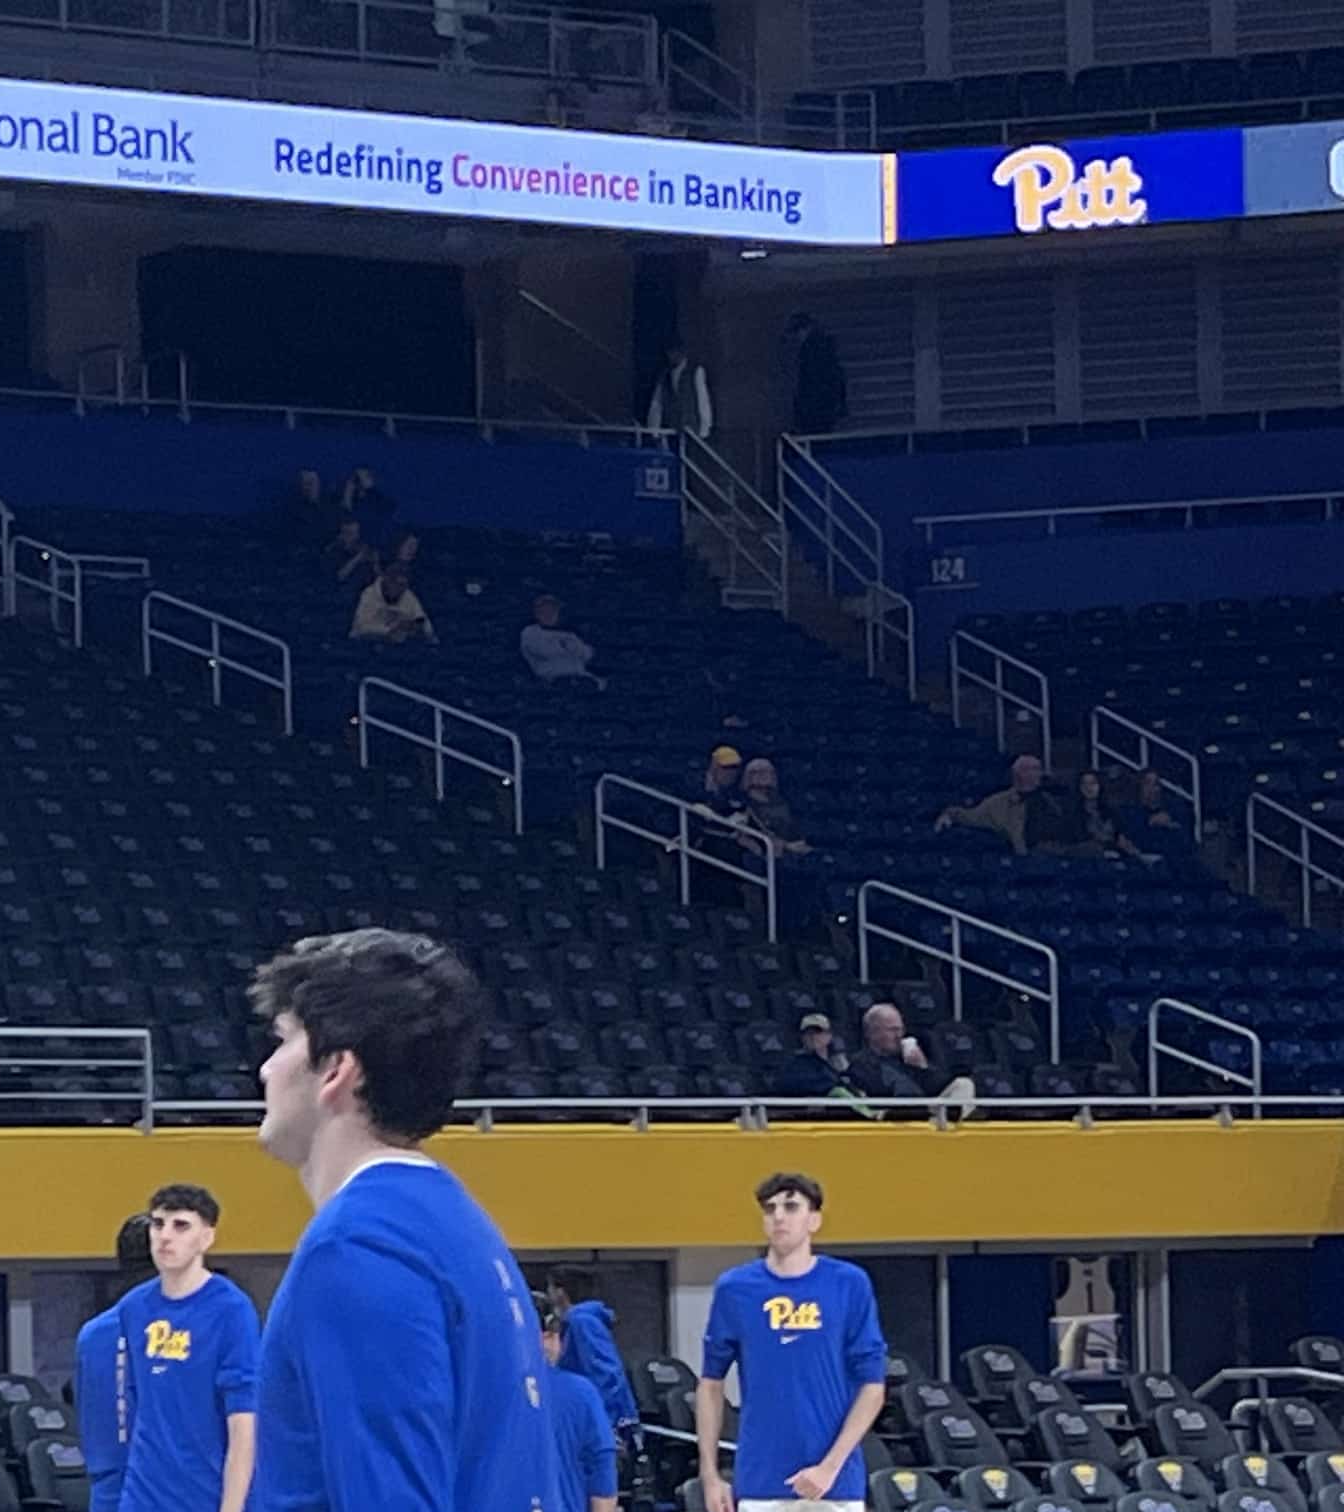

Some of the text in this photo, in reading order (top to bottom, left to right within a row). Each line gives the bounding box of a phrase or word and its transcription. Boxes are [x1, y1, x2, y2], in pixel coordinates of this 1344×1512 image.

[92, 112, 195, 164] Bank
[274, 138, 802, 224] Redefining Convenience in Banking
[992, 144, 1147, 232] Pitt
[762, 1295, 823, 1330] Pitt
